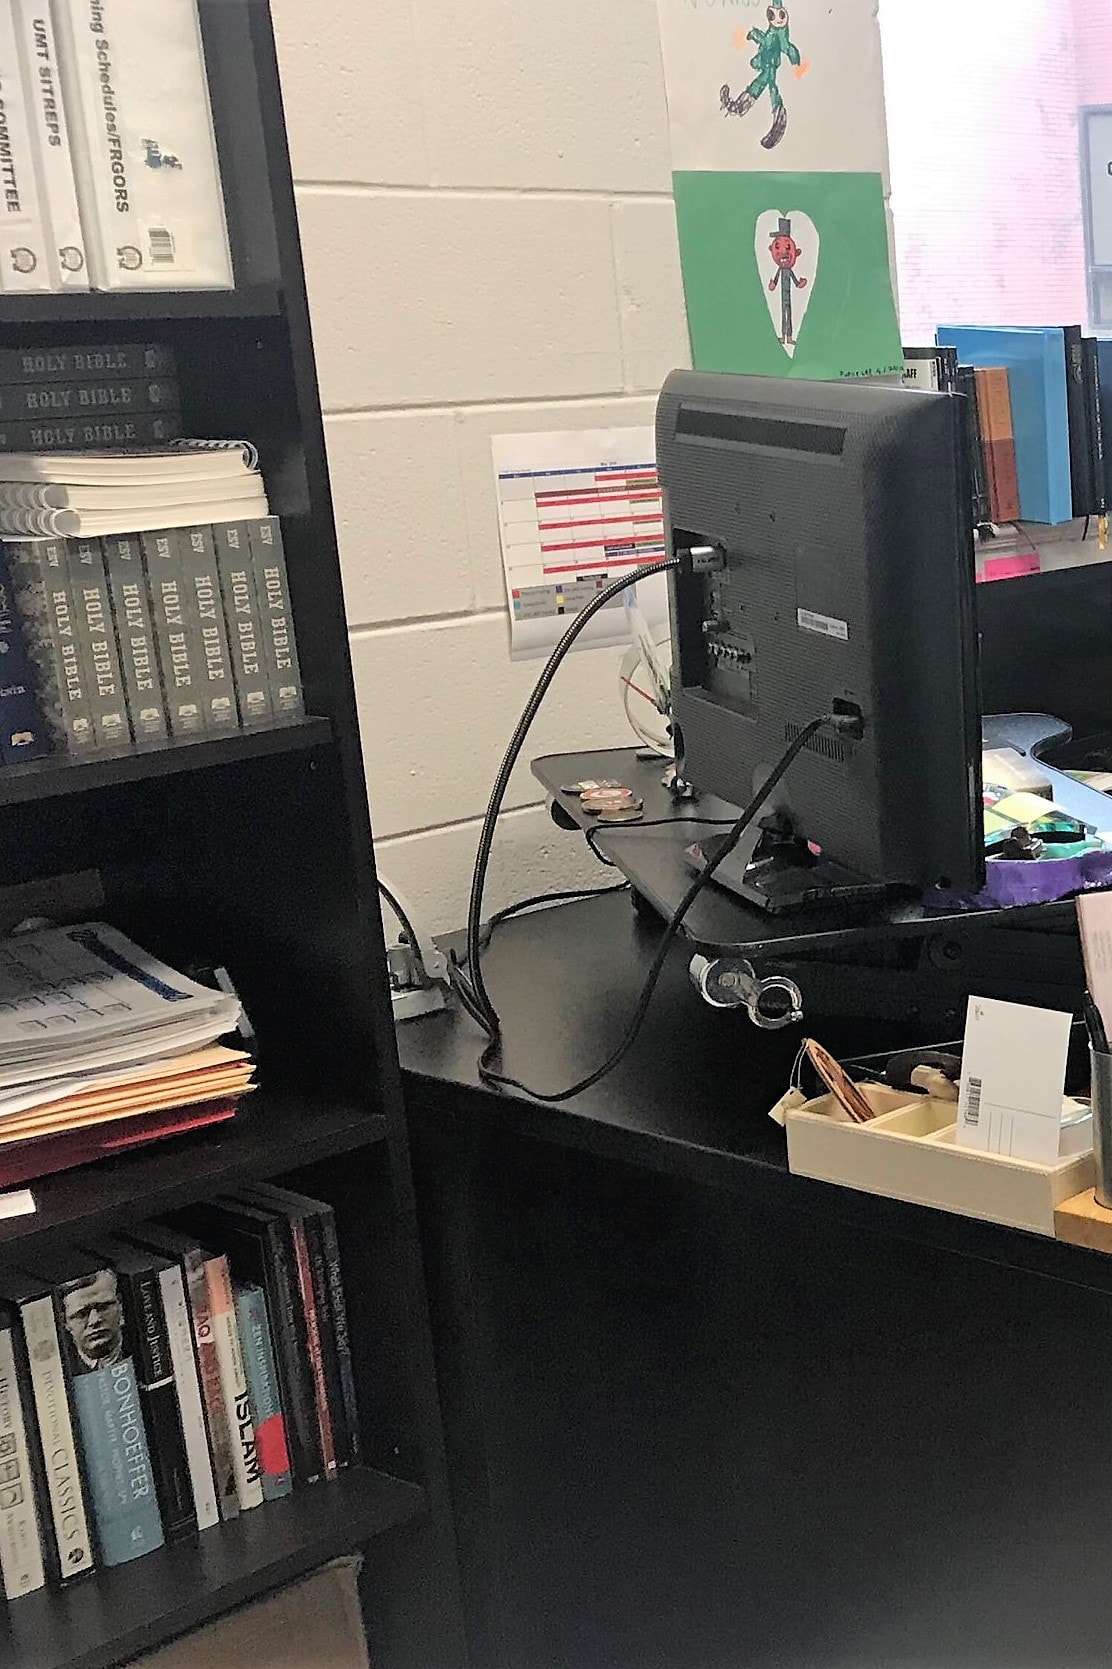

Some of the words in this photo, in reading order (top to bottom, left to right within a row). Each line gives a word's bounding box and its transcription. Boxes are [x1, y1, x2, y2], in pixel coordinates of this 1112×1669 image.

[32, 18, 49, 61] UMT
[38, 66, 61, 147] SITREPS
[95, 38, 129, 214] Schedules/FRGORS
[21, 352, 66, 372] HOLY
[73, 350, 127, 370] BIBLE
[26, 390, 72, 409] HOLY
[78, 386, 132, 406] BIBLE
[30, 427, 75, 446] HOLY
[84, 423, 137, 443] BIBLE
[155, 538, 172, 559] ESV
[190, 532, 206, 553] ESV
[226, 529, 241, 549] ESV
[260, 526, 275, 545] ESV
[83, 587, 106, 634] HOLY
[123, 583, 144, 628] HOLY
[161, 580, 182, 625] HOLY
[194, 575, 215, 619] HOLY
[230, 570, 251, 615] HOLY
[263, 567, 285, 611] HOLY
[52, 591, 73, 637] HOLY
[131, 636, 153, 691] BIBLE
[170, 632, 193, 688] BIBLE
[202, 627, 225, 681] BIBLE
[238, 622, 259, 675] BIBLE
[269, 616, 292, 669] BIBLE
[61, 644, 82, 700] BIBLE
[91, 641, 116, 697] BIBLE
[111, 1365, 150, 1500] BONHOEFFER
[235, 1391, 260, 1484] ISLAM
[51, 1448, 80, 1542] CLASSICS
